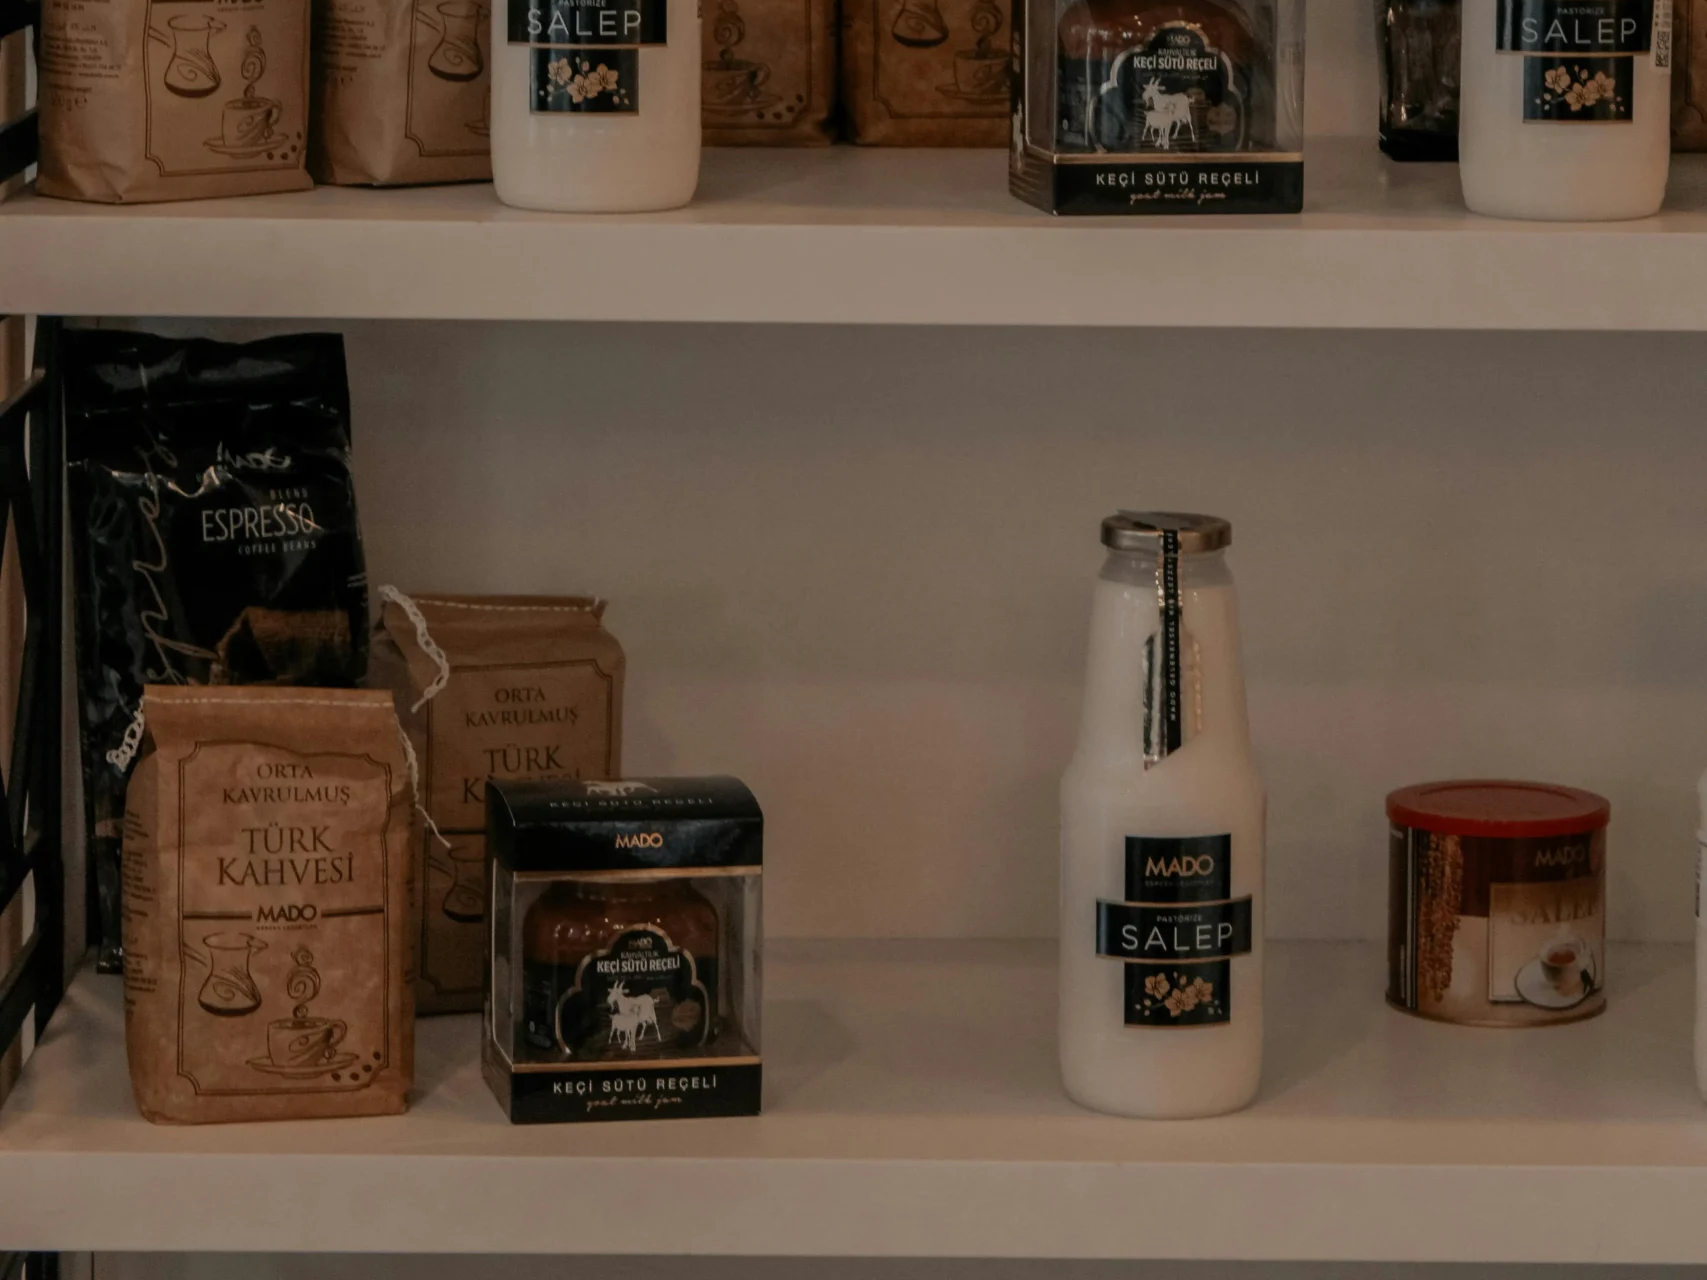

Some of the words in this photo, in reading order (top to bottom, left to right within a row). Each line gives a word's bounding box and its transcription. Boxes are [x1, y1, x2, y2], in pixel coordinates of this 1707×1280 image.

[527, 9, 641, 36] SALEP
[1521, 18, 1637, 44] SALEP
[1133, 55, 1157, 70] KEÇİ
[1158, 54, 1185, 70] SÜTÜ
[1096, 171, 1135, 188] KEÇİ
[1144, 171, 1190, 186] SÜTÜ
[1199, 170, 1259, 188] REÇELİ
[202, 503, 314, 541] ESPRESSO
[495, 686, 546, 703] ORTA
[466, 705, 578, 727] KAVRULMUŞ
[483, 743, 564, 773] TÜRK
[257, 763, 313, 779] ORTA
[223, 785, 350, 805] KAVRULMUŞ
[242, 822, 335, 854] TÜRK
[615, 832, 663, 849] MADO
[1145, 854, 1214, 877] MADO
[1534, 842, 1586, 867] MADO
[217, 851, 354, 886] KAHVESİ
[256, 904, 317, 922] MADO
[1121, 922, 1233, 952] SALEP
[597, 959, 619, 974] KEÇİ
[621, 958, 648, 973] SÜTÜ
[649, 955, 680, 972] REÇELİ
[553, 1079, 593, 1096] KEÇİ
[602, 1077, 647, 1093] SÜTÜ
[656, 1074, 717, 1091] REÇELİ
